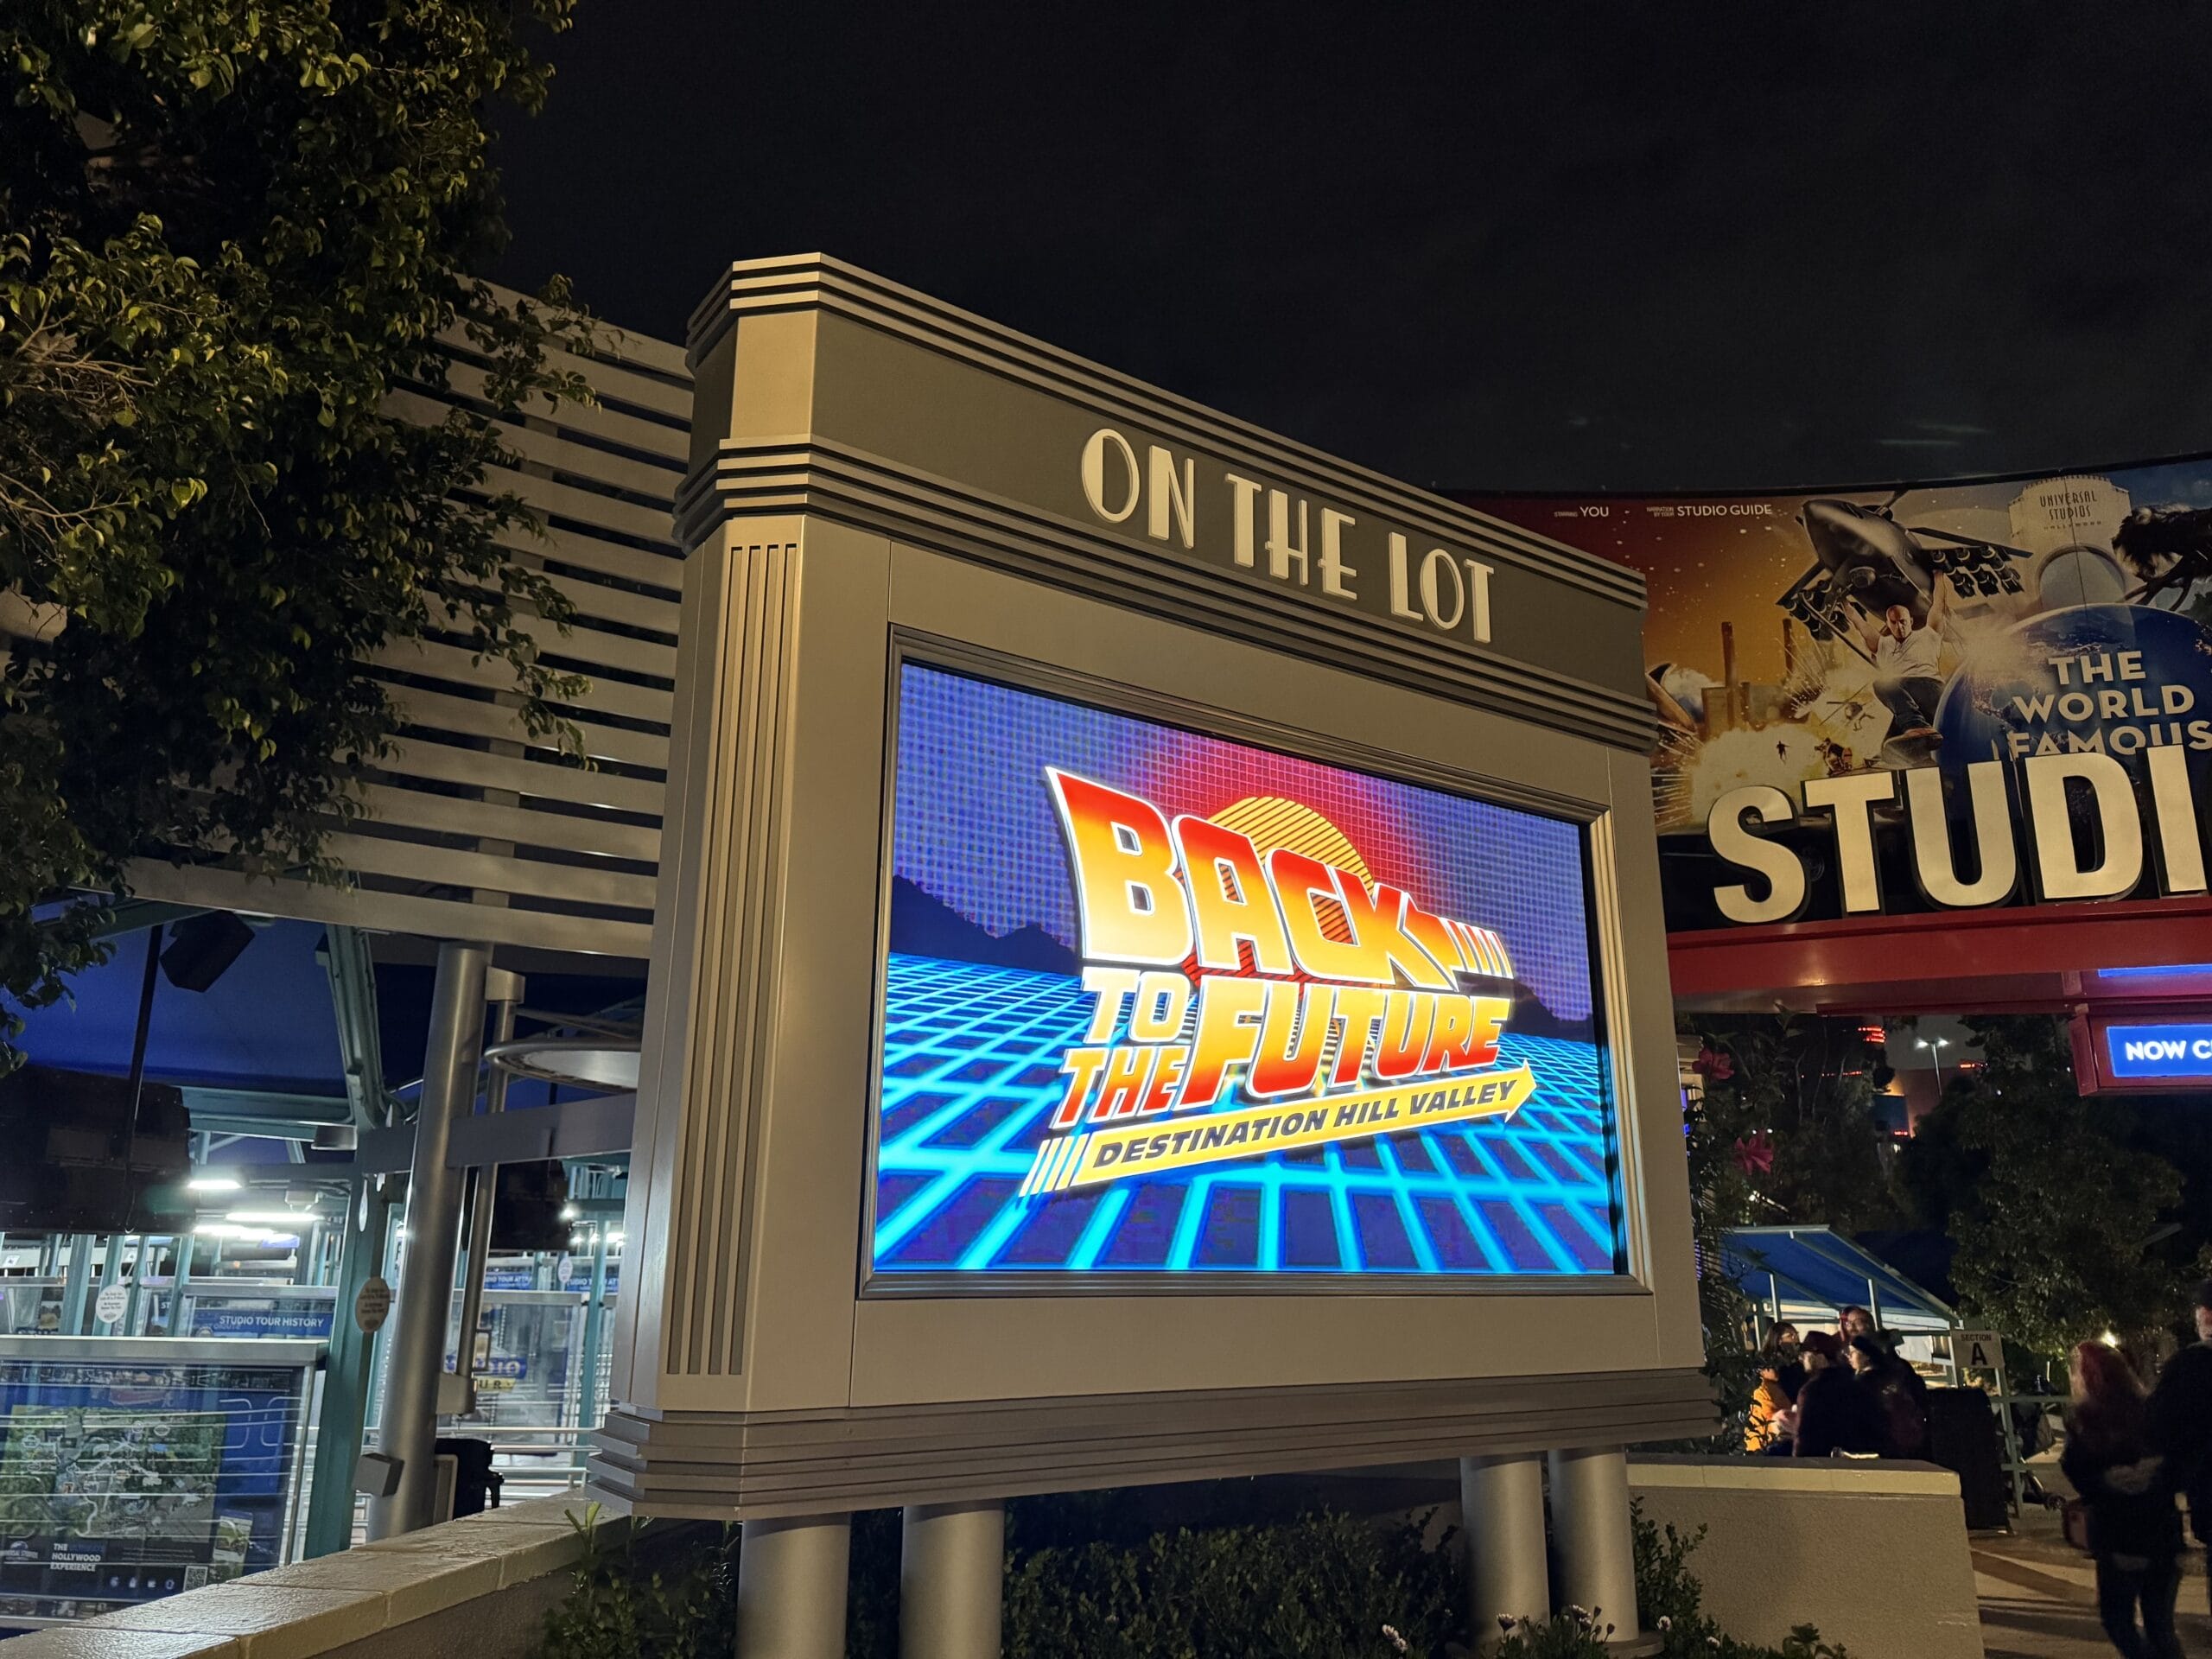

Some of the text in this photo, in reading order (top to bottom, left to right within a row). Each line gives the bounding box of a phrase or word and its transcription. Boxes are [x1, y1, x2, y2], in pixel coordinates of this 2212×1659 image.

[1580, 506, 1609, 517] YOU
[1677, 505, 1772, 517] STUDIO GUIDE
[2040, 491, 2097, 508] UNIVERSAL
[2049, 505, 2092, 520] STUDIOS
[1082, 429, 1495, 644] ON THE LOT
[2048, 651, 2146, 685] THE
[2012, 685, 2195, 724] WORLD
[2006, 721, 2212, 762] FAMOUS
[1707, 744, 2208, 924] STUDI
[1045, 766, 1513, 992] BACK
[1082, 966, 1192, 1045] TO
[1179, 975, 1511, 1109] FUTURE
[2125, 1039, 2212, 1061] NOW C
[1050, 1045, 1191, 1128] THE
[1093, 1080, 1517, 1167] DESTINATION HILL VALLEY
[219, 1315, 324, 1328] STUDIO TOUR HISTORY
[1971, 1342, 1987, 1365] A
[52, 1552, 101, 1562] HOLLYWOOD
[54, 1542, 67, 1551] THE
[50, 1562, 96, 1572] EXPERIENCE
